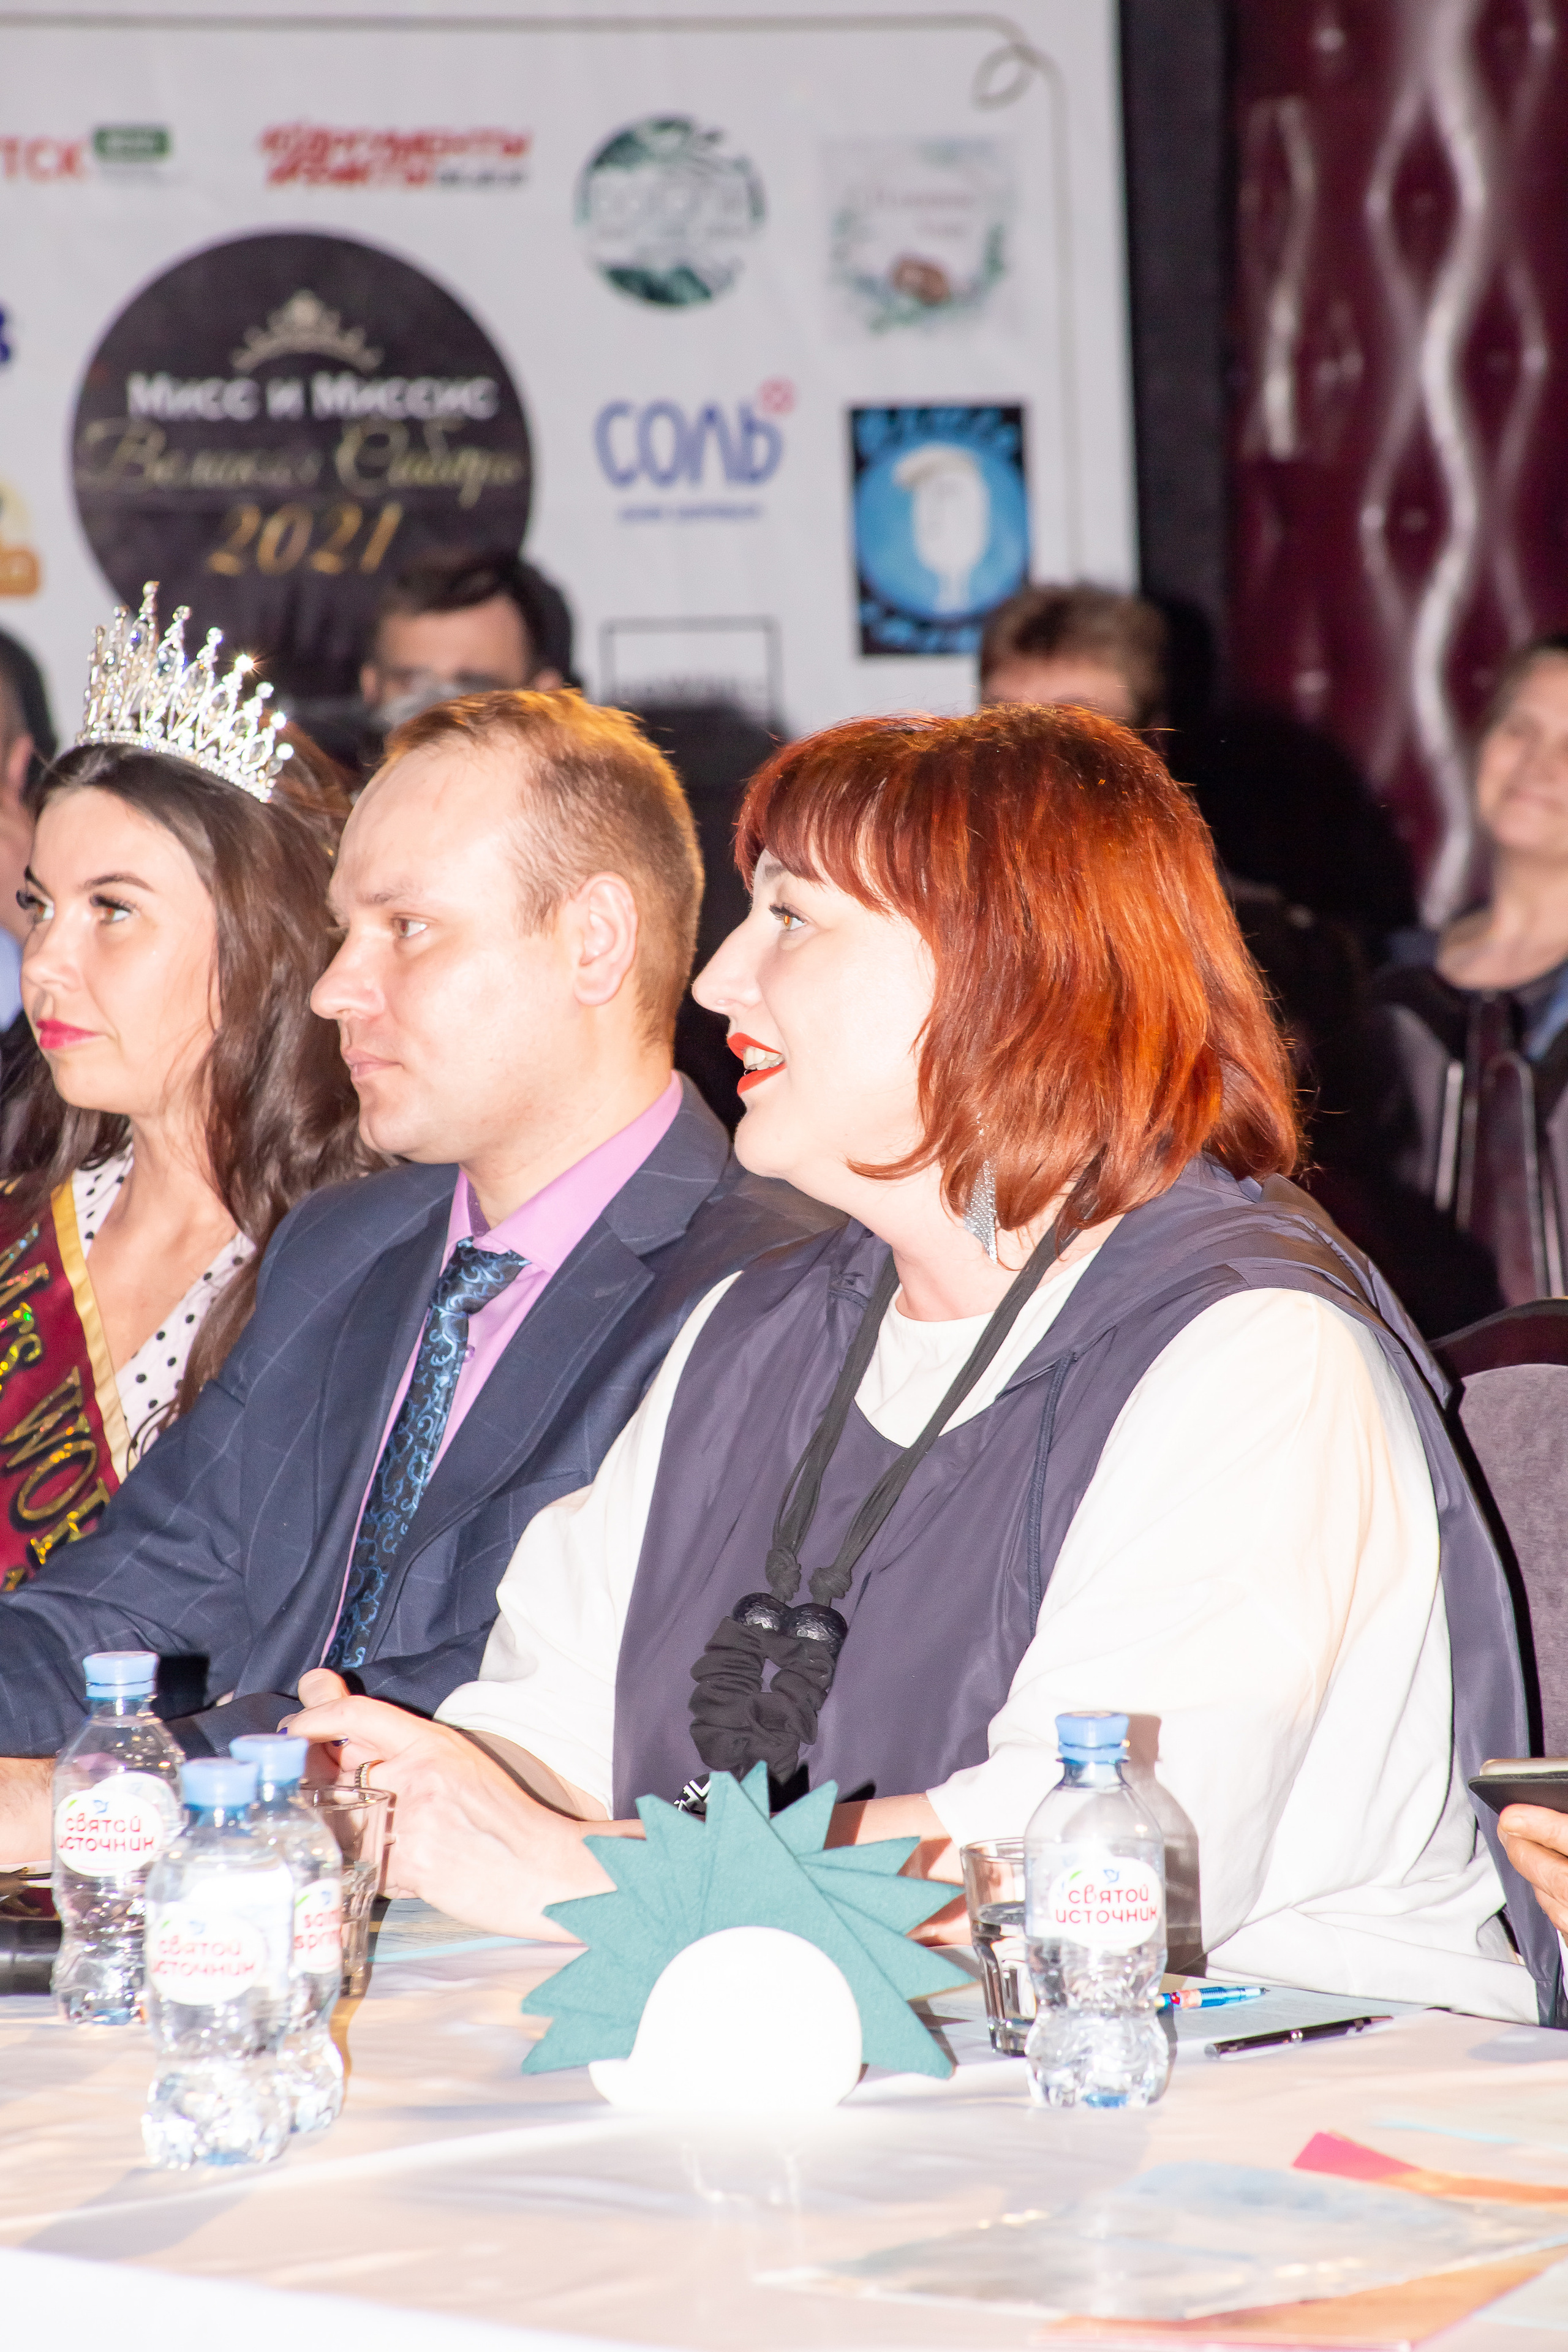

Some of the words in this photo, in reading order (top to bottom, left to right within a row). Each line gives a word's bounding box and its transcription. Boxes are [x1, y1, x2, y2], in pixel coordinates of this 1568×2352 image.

[127, 372, 260, 420] Мисс
[265, 377, 305, 420] и
[311, 371, 499, 420] Миссис
[207, 501, 403, 576] 2021
[1068, 1883, 1148, 1904] святой
[1055, 1905, 1158, 1924] источник
